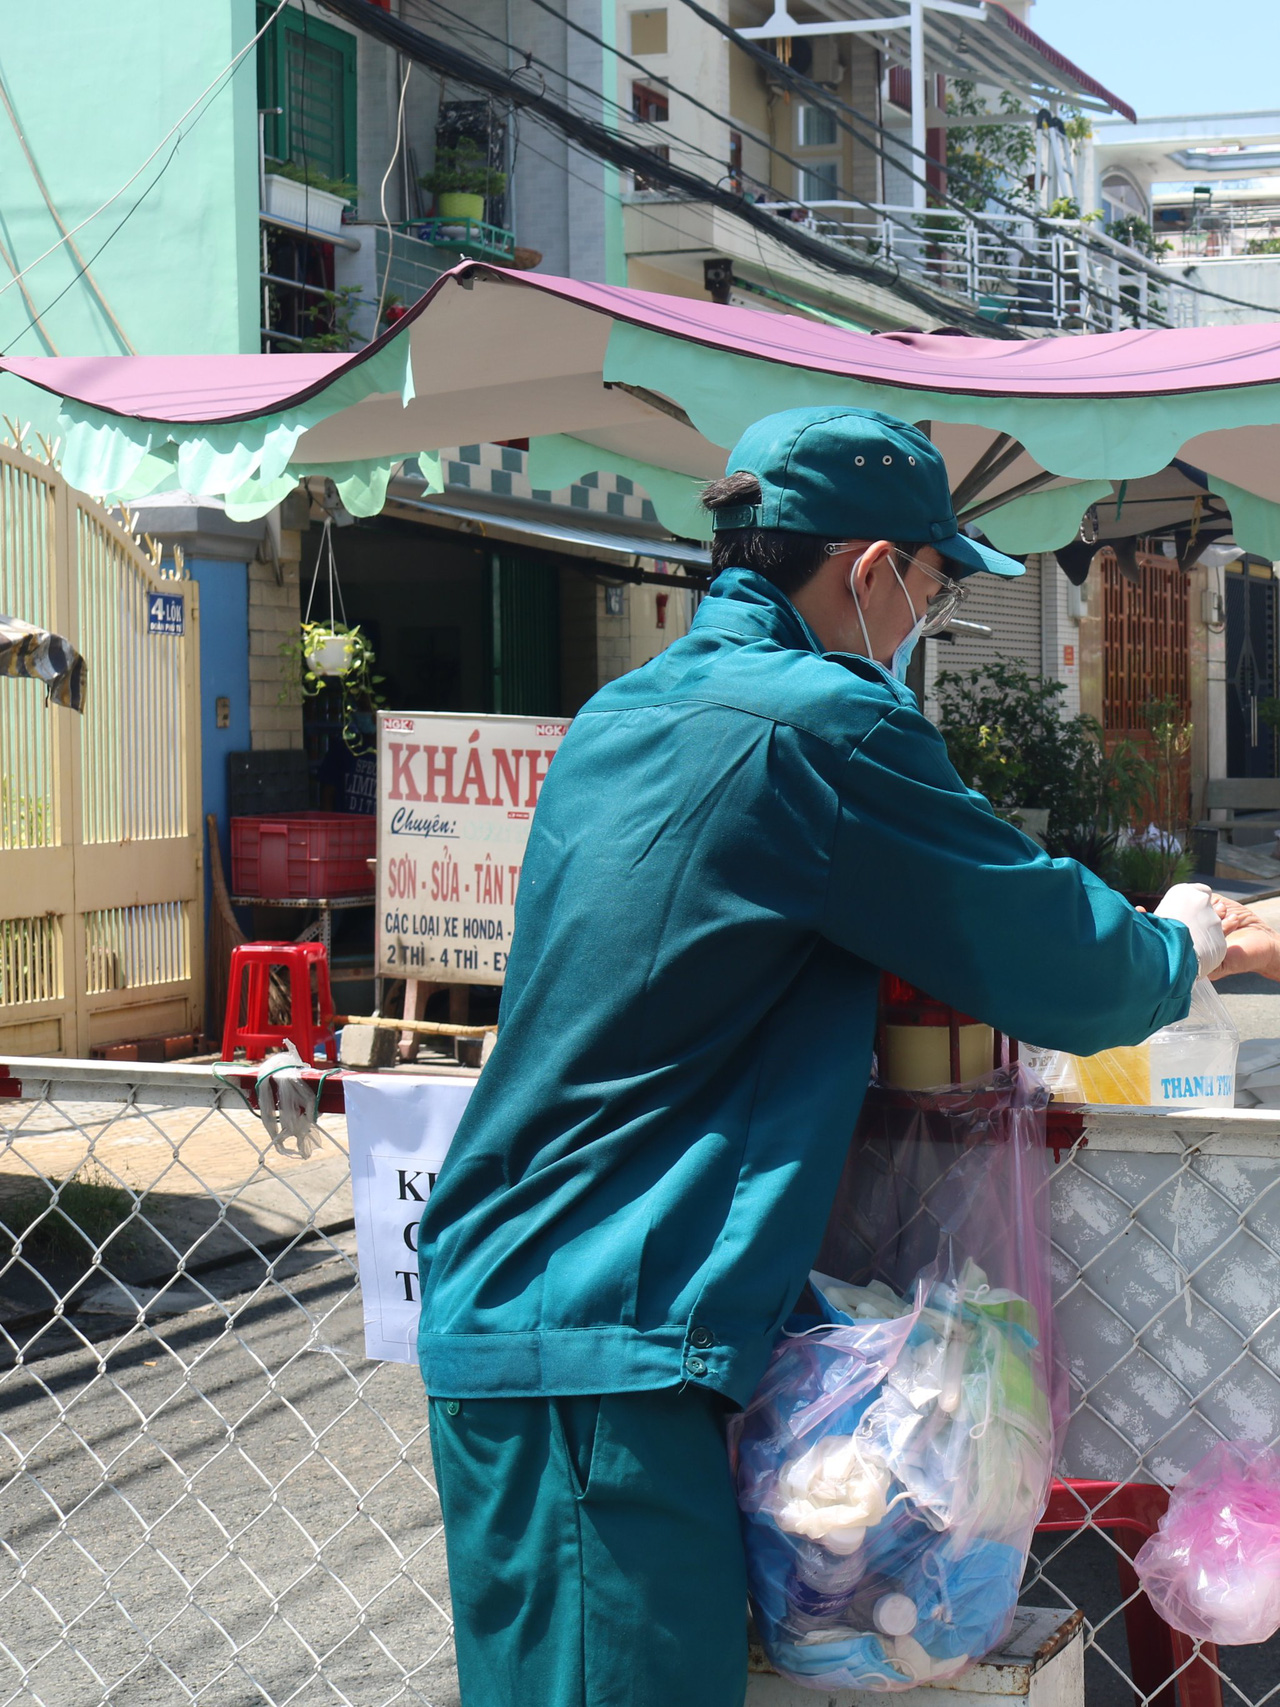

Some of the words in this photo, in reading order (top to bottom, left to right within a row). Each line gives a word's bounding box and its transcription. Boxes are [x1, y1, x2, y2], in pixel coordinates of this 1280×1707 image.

[151, 598, 165, 620] 4
[537, 725, 562, 736] NGK
[345, 772, 377, 798] LIM
[390, 806, 457, 838] Chuyên:
[388, 853, 417, 900] SƠN
[431, 845, 460, 902] SỬA
[474, 853, 503, 905] TÂN
[509, 865, 521, 905] T
[385, 908, 409, 935] CÁC
[413, 914, 440, 940] LOẠI
[443, 916, 459, 937] XE
[463, 918, 504, 941] HONDA
[387, 945, 396, 964] 2
[401, 941, 425, 967] THÌ
[440, 948, 449, 967] 4
[454, 945, 478, 970] THÌ
[1161, 1076, 1214, 1099] THANH
[1216, 1074, 1233, 1096] TH
